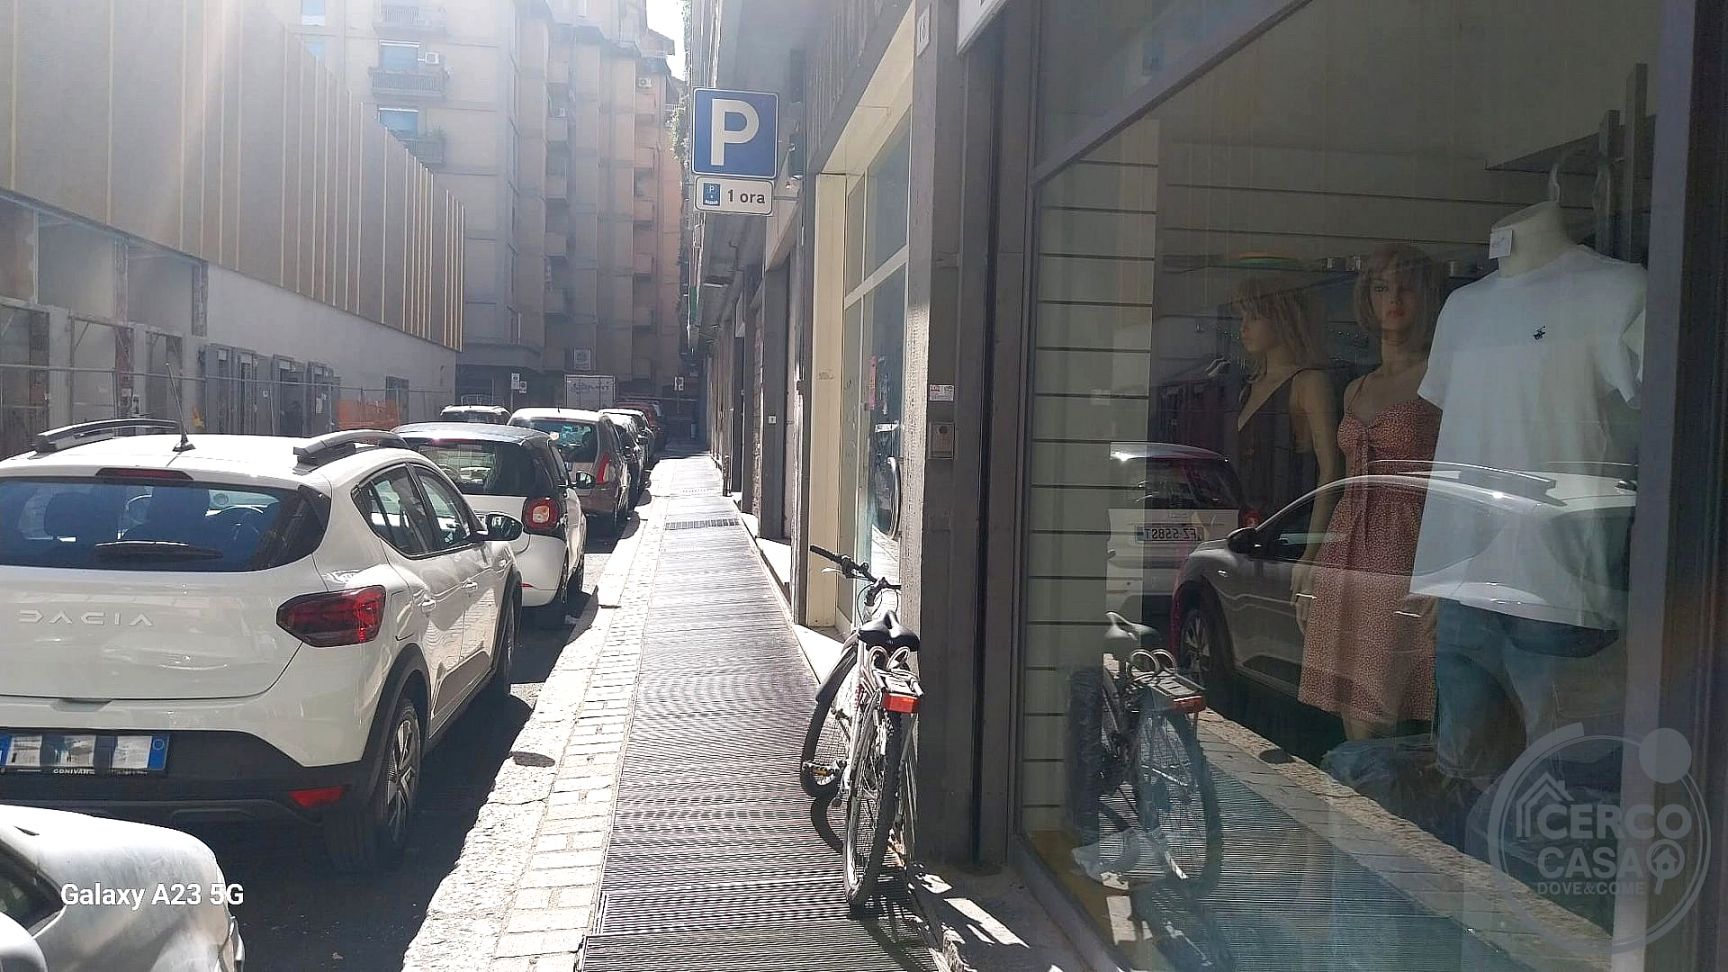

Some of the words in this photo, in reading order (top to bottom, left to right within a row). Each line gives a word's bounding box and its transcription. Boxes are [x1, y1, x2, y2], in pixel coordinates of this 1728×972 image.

[710, 98, 760, 166] P
[727, 189, 734, 202] 1
[740, 192, 766, 204] ora
[19, 609, 153, 626] DACIA
